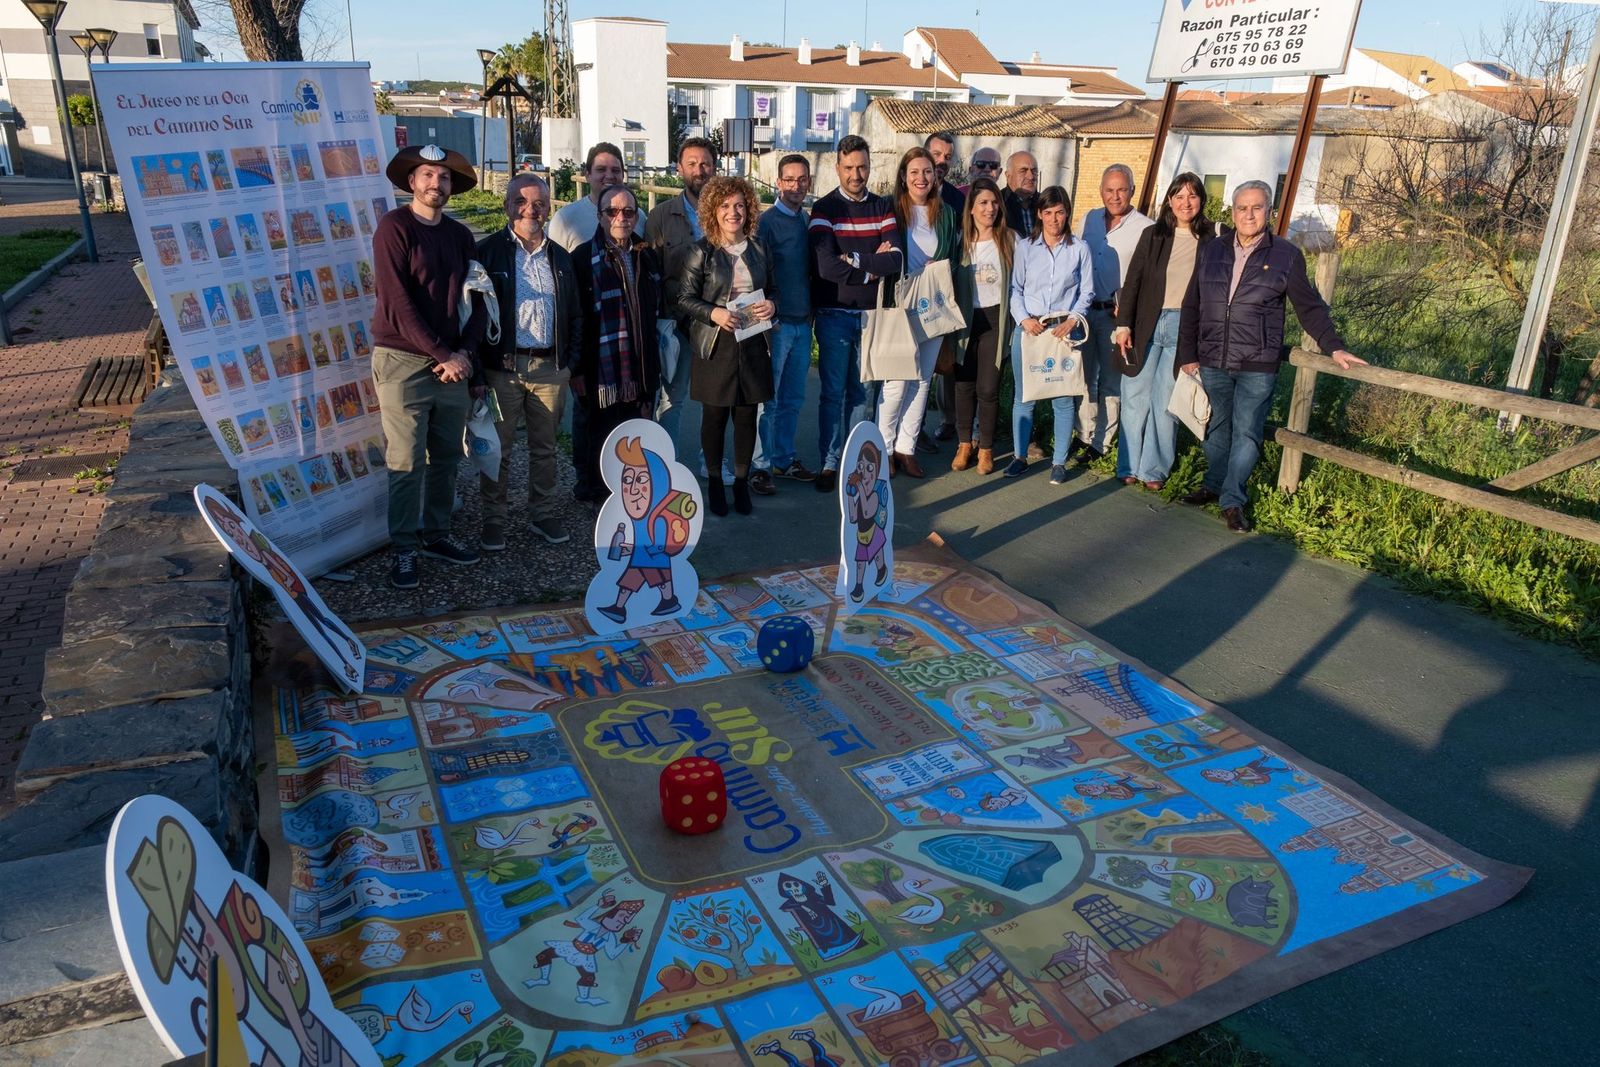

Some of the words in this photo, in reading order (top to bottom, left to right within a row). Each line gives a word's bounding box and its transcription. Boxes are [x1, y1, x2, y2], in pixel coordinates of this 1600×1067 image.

[1180, 17, 1223, 33] Razón
[1216, 31, 1240, 43] 675
[1245, 29, 1262, 41] 95
[1267, 26, 1284, 38] 78
[1288, 24, 1307, 35] 22
[1213, 44, 1237, 56] 615
[1243, 42, 1259, 54] 70
[1263, 40, 1280, 52] 63
[1285, 38, 1304, 49] 69
[1210, 57, 1234, 69] 670
[1238, 55, 1256, 67] 49
[1260, 54, 1277, 65] 06
[1283, 52, 1301, 64] 05
[261, 100, 304, 115] Camino
[816, 729, 864, 757] H
[922, 749, 960, 774] ACEITE
[888, 762, 922, 787] MUSEO
[828, 854, 841, 862] 59
[751, 876, 765, 886] 58
[992, 921, 1019, 936] 34-35
[470, 973, 482, 983] 27
[820, 976, 834, 986] 32
[609, 1028, 645, 1046] 29-30
